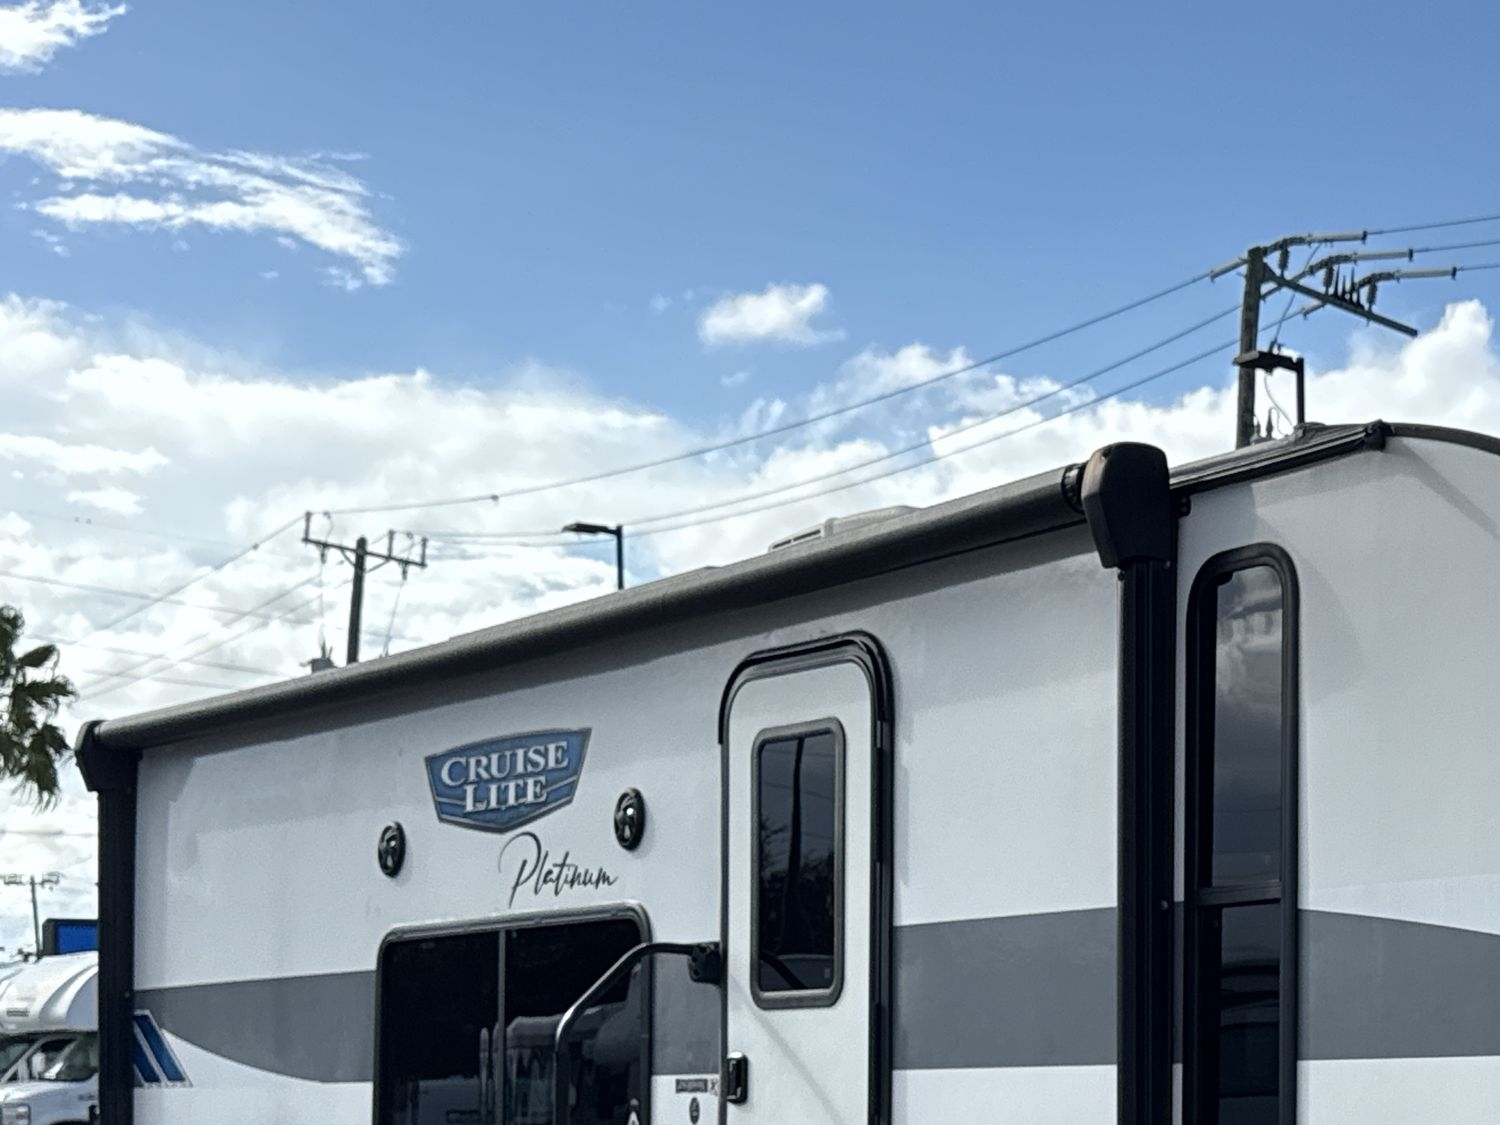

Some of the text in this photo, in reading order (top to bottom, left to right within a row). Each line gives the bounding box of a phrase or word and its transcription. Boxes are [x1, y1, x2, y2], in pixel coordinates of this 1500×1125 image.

[441, 741, 568, 786] CRUISE
[463, 776, 547, 814] LITE
[498, 831, 617, 909] Platinum
